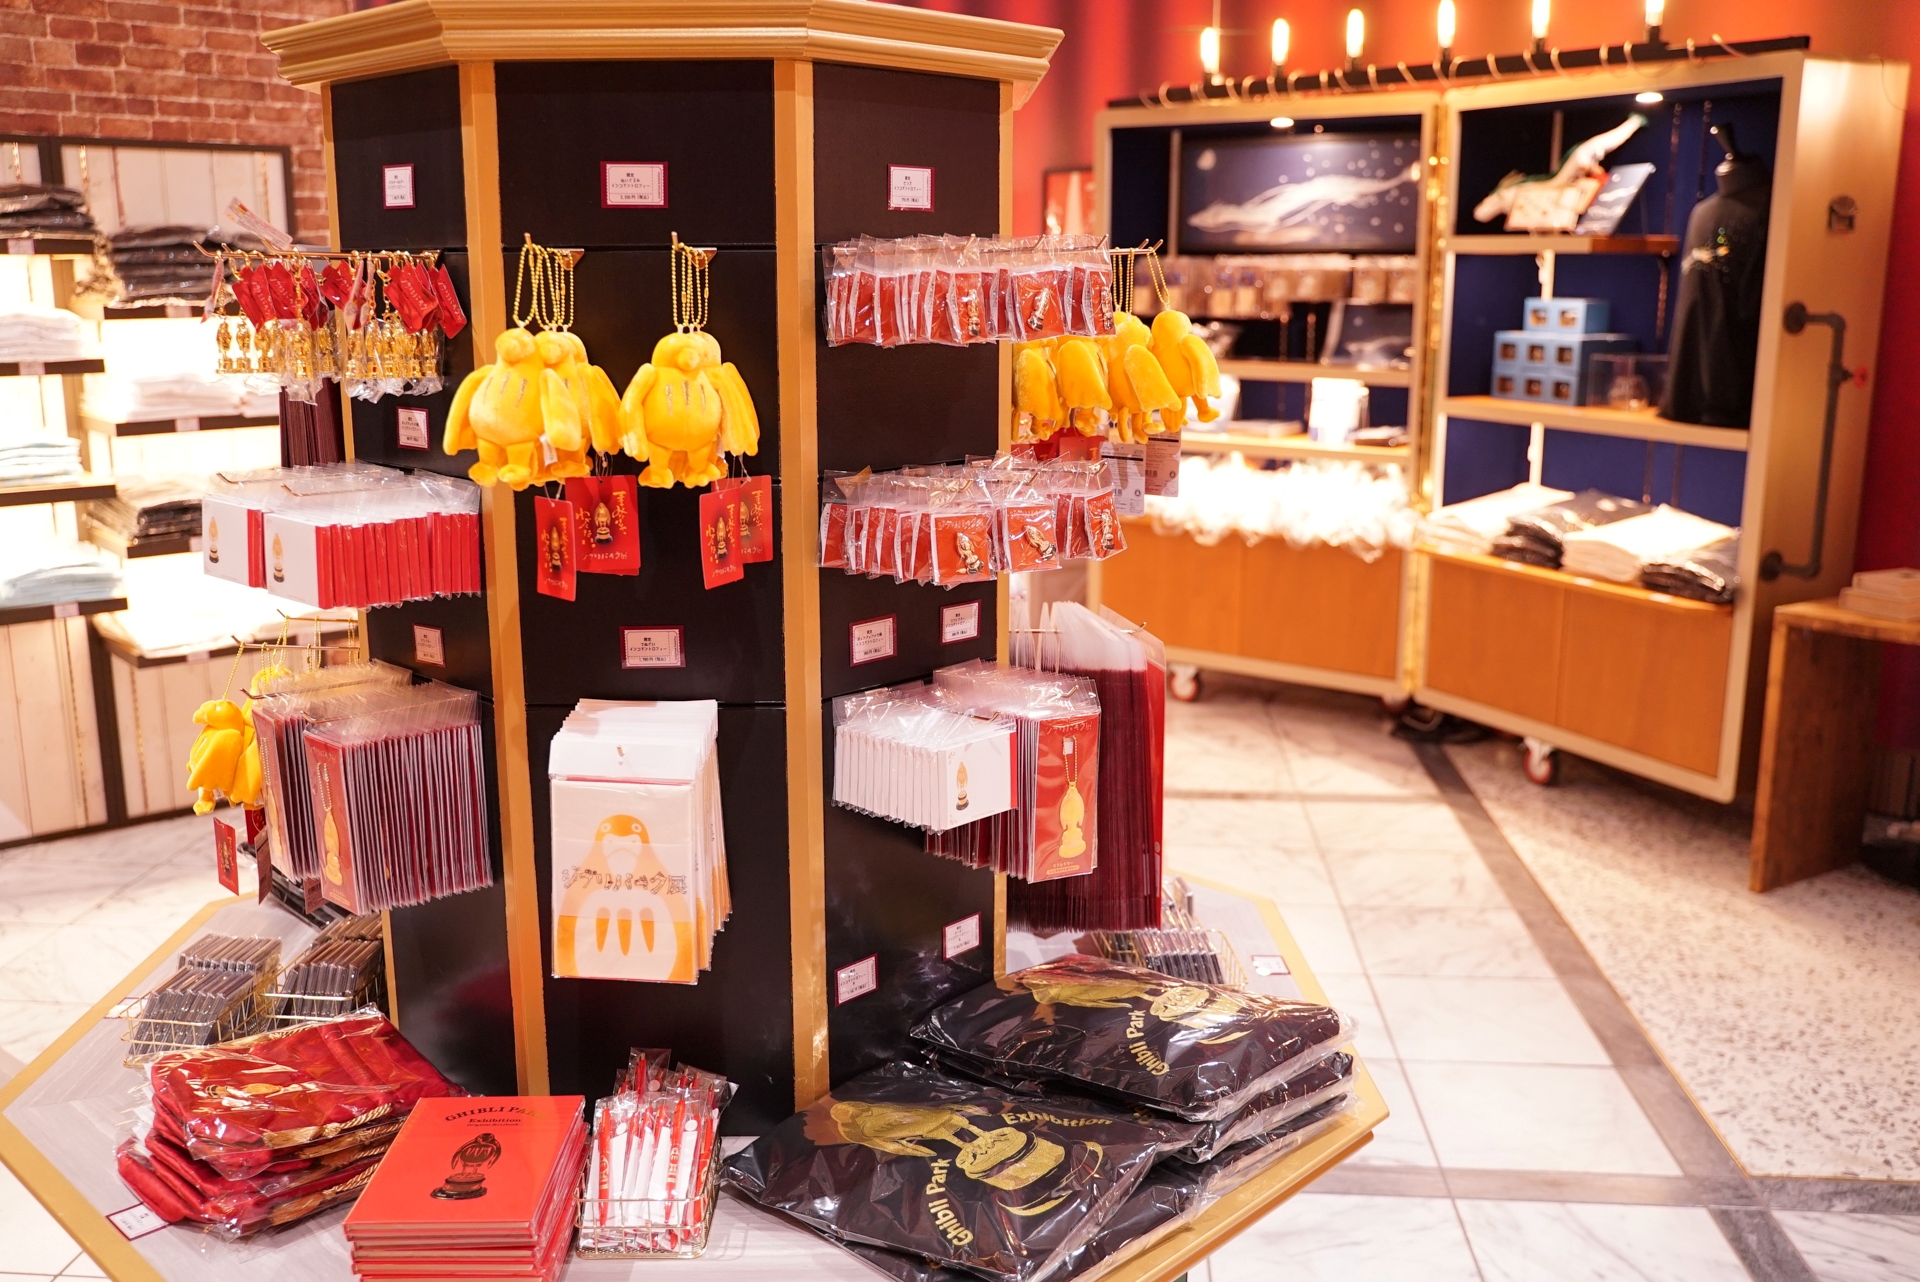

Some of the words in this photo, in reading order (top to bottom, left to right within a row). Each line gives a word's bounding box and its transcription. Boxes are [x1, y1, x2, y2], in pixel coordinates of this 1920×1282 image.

[562, 865, 687, 896] ジブリパーク展
[1126, 1009, 1147, 1039] Park
[1128, 1040, 1170, 1076] Ghibli
[445, 1106, 506, 1122] GHIBLI
[1001, 1110, 1113, 1127] Exhibition
[925, 1158, 953, 1196] Park
[928, 1198, 974, 1247] Ghibli
